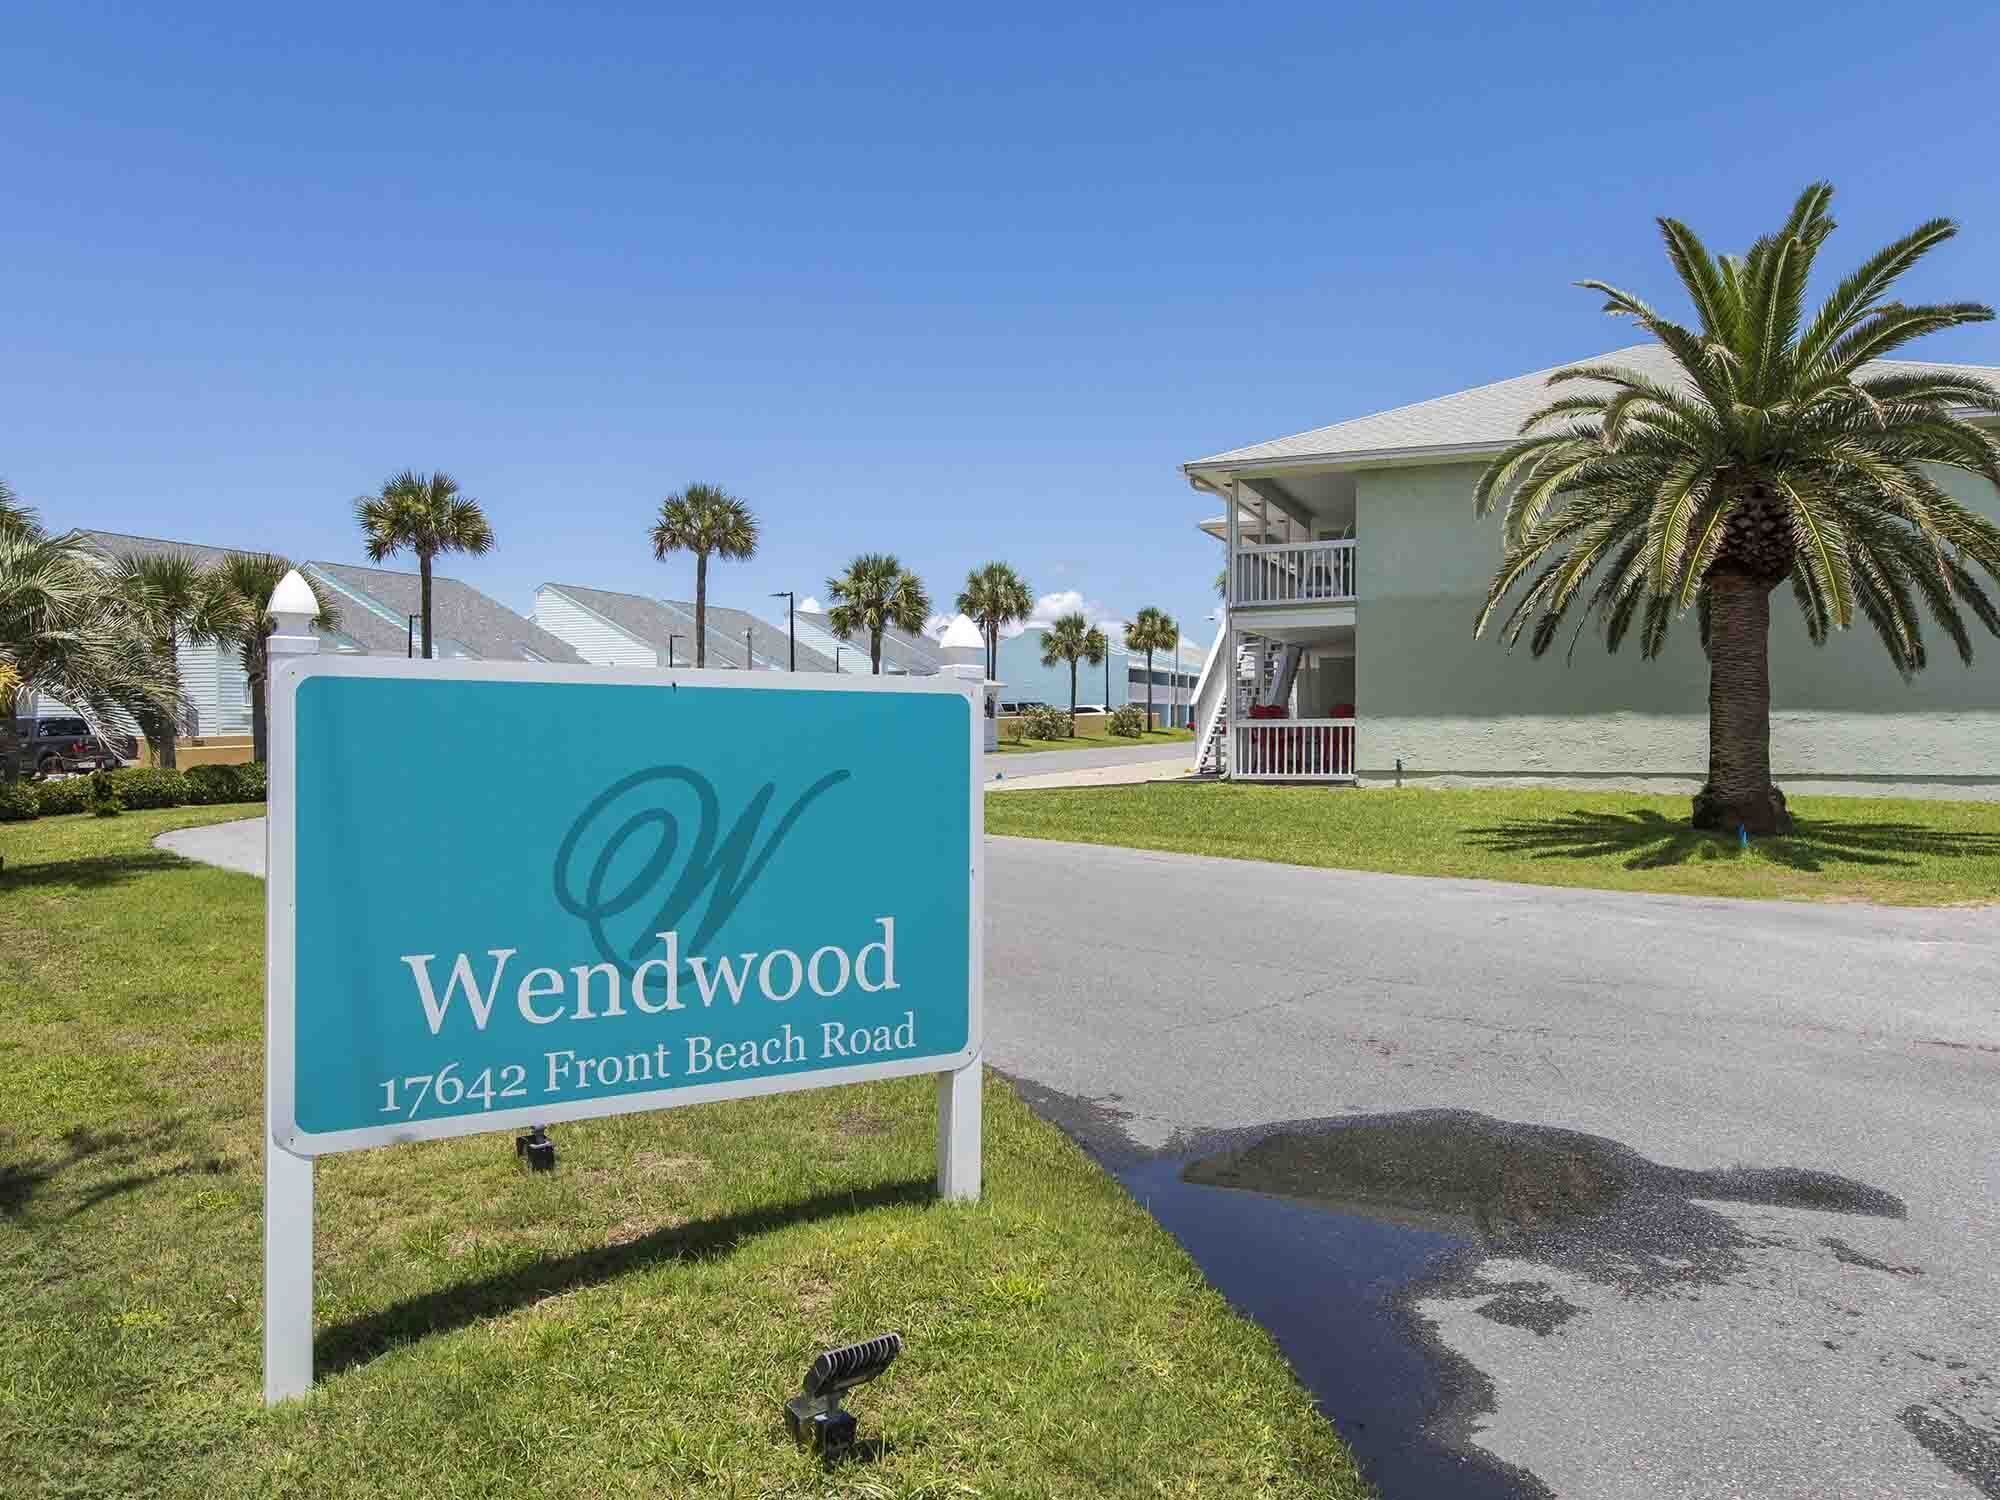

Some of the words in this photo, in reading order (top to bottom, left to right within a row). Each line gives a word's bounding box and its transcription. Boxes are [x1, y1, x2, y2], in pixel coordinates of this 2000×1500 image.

[400, 916, 901, 1034] Wendwood
[379, 1062, 528, 1119] 17642
[543, 1043, 672, 1092] Front
[685, 1023, 807, 1075] Beach
[820, 1010, 917, 1059] Road
